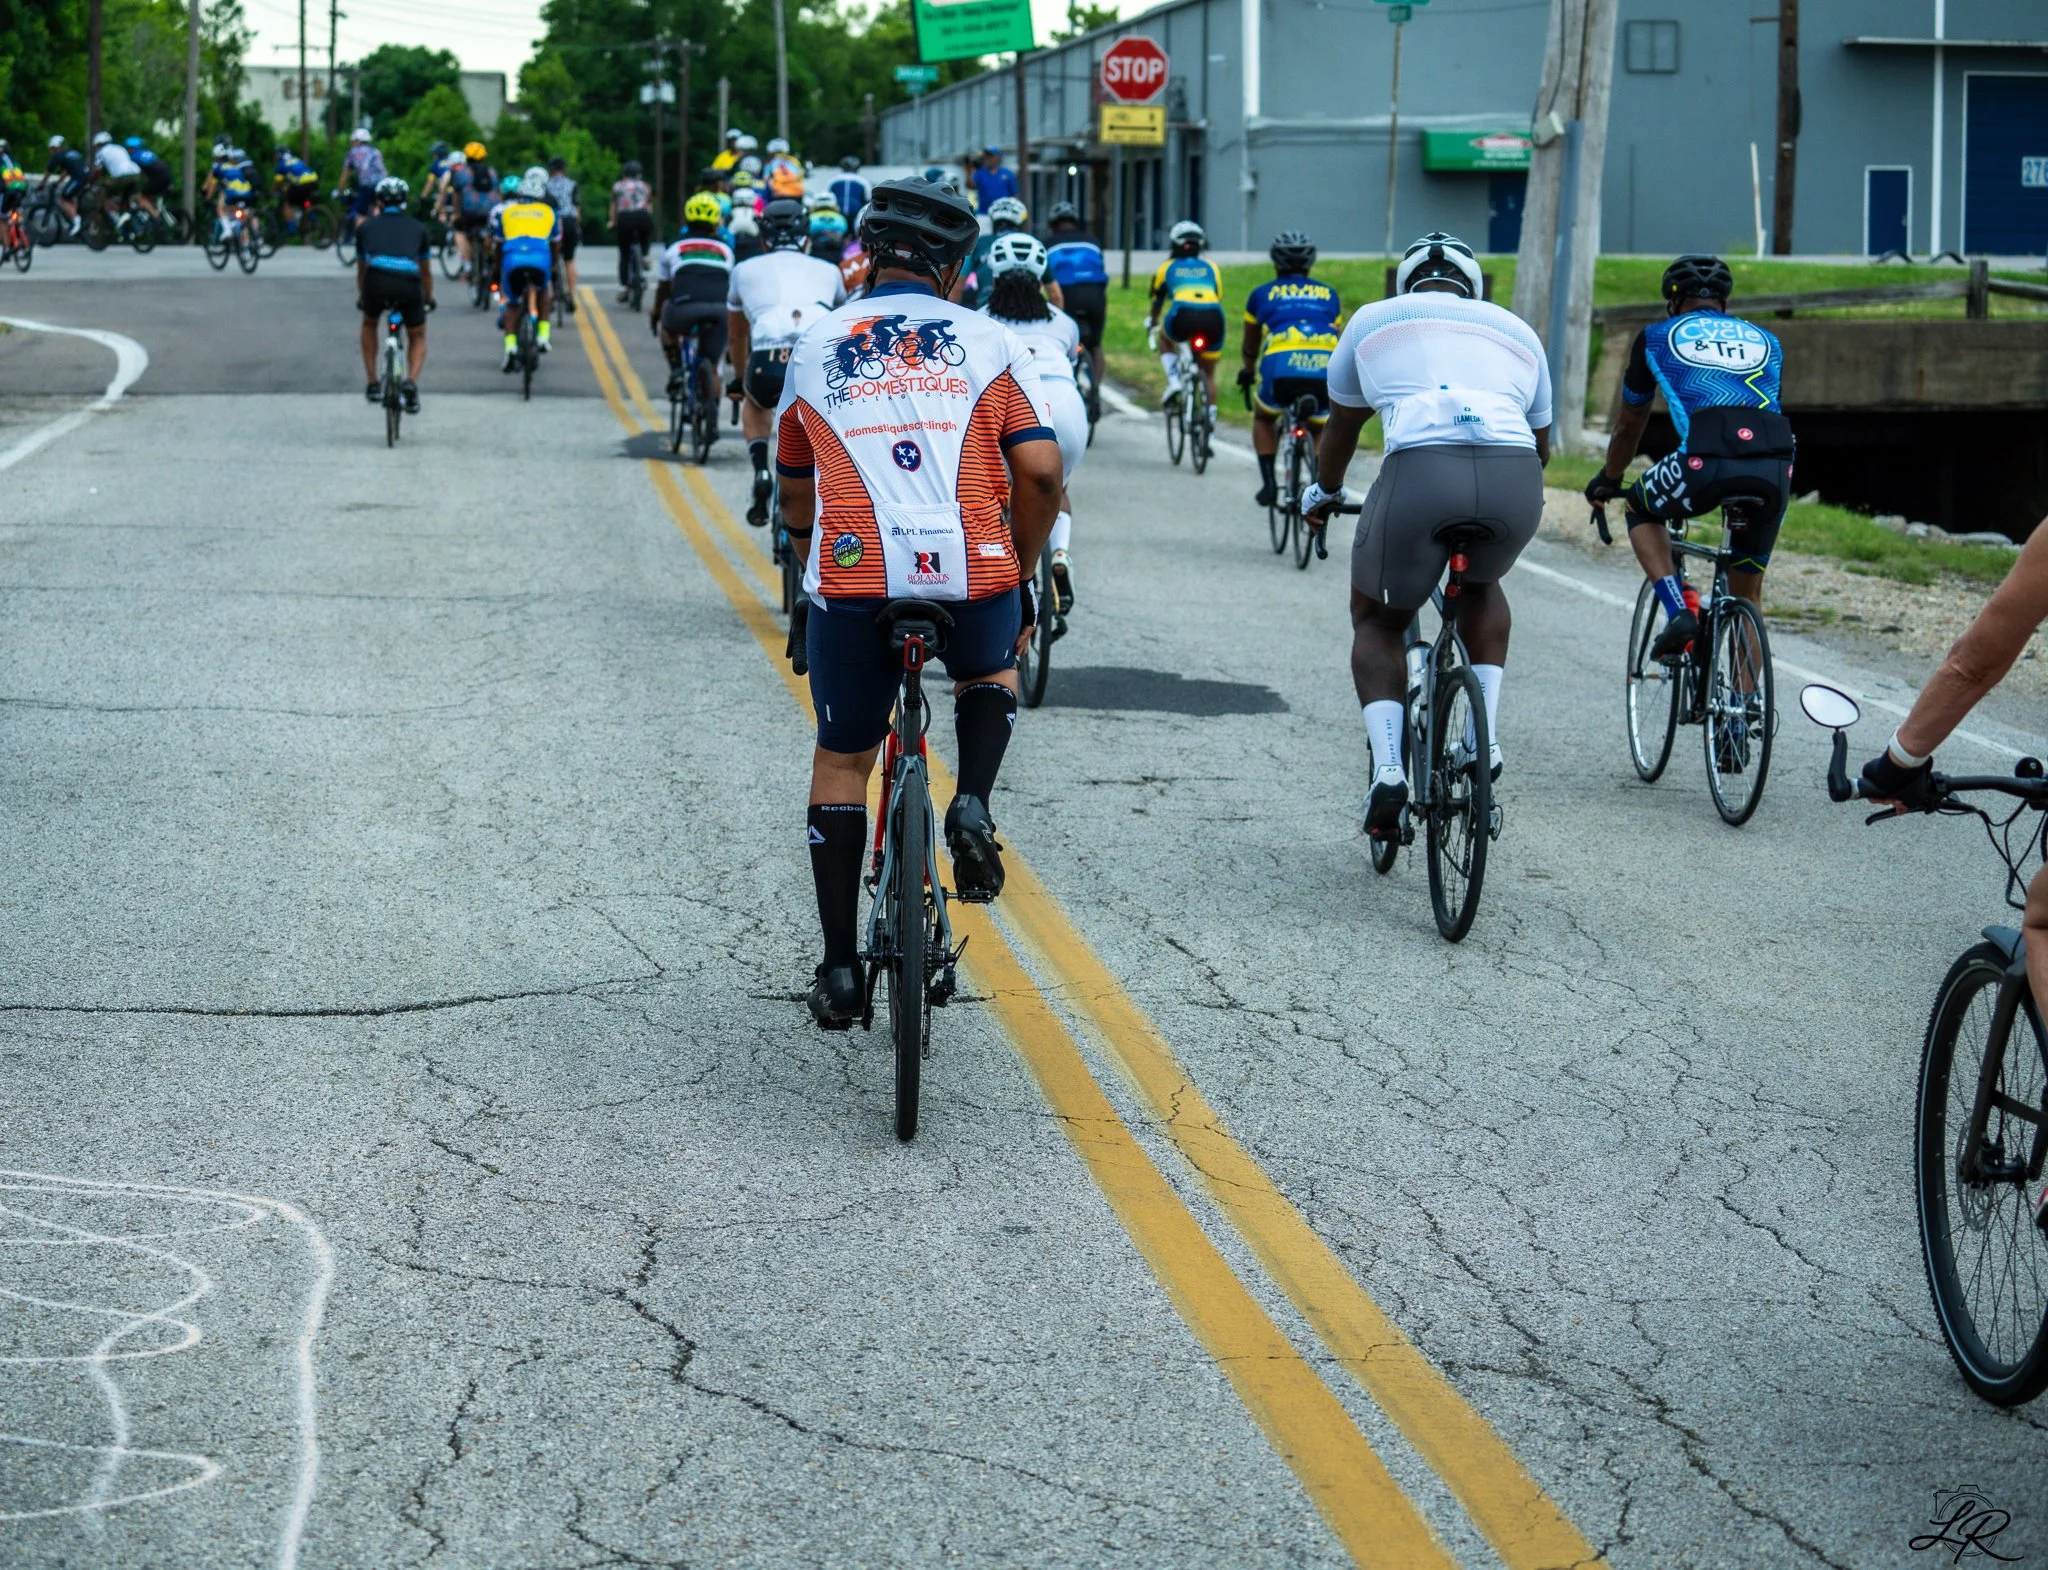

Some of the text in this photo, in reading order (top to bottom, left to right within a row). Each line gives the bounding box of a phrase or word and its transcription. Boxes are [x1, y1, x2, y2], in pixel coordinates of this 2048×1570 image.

[1106, 56, 1164, 84] STOP
[1699, 317, 1734, 329] Pro
[1680, 323, 1761, 342] Cycle
[1695, 340, 1745, 360] & Tri
[901, 528, 918, 536] LPL
[907, 573, 950, 582] ROLANDS
